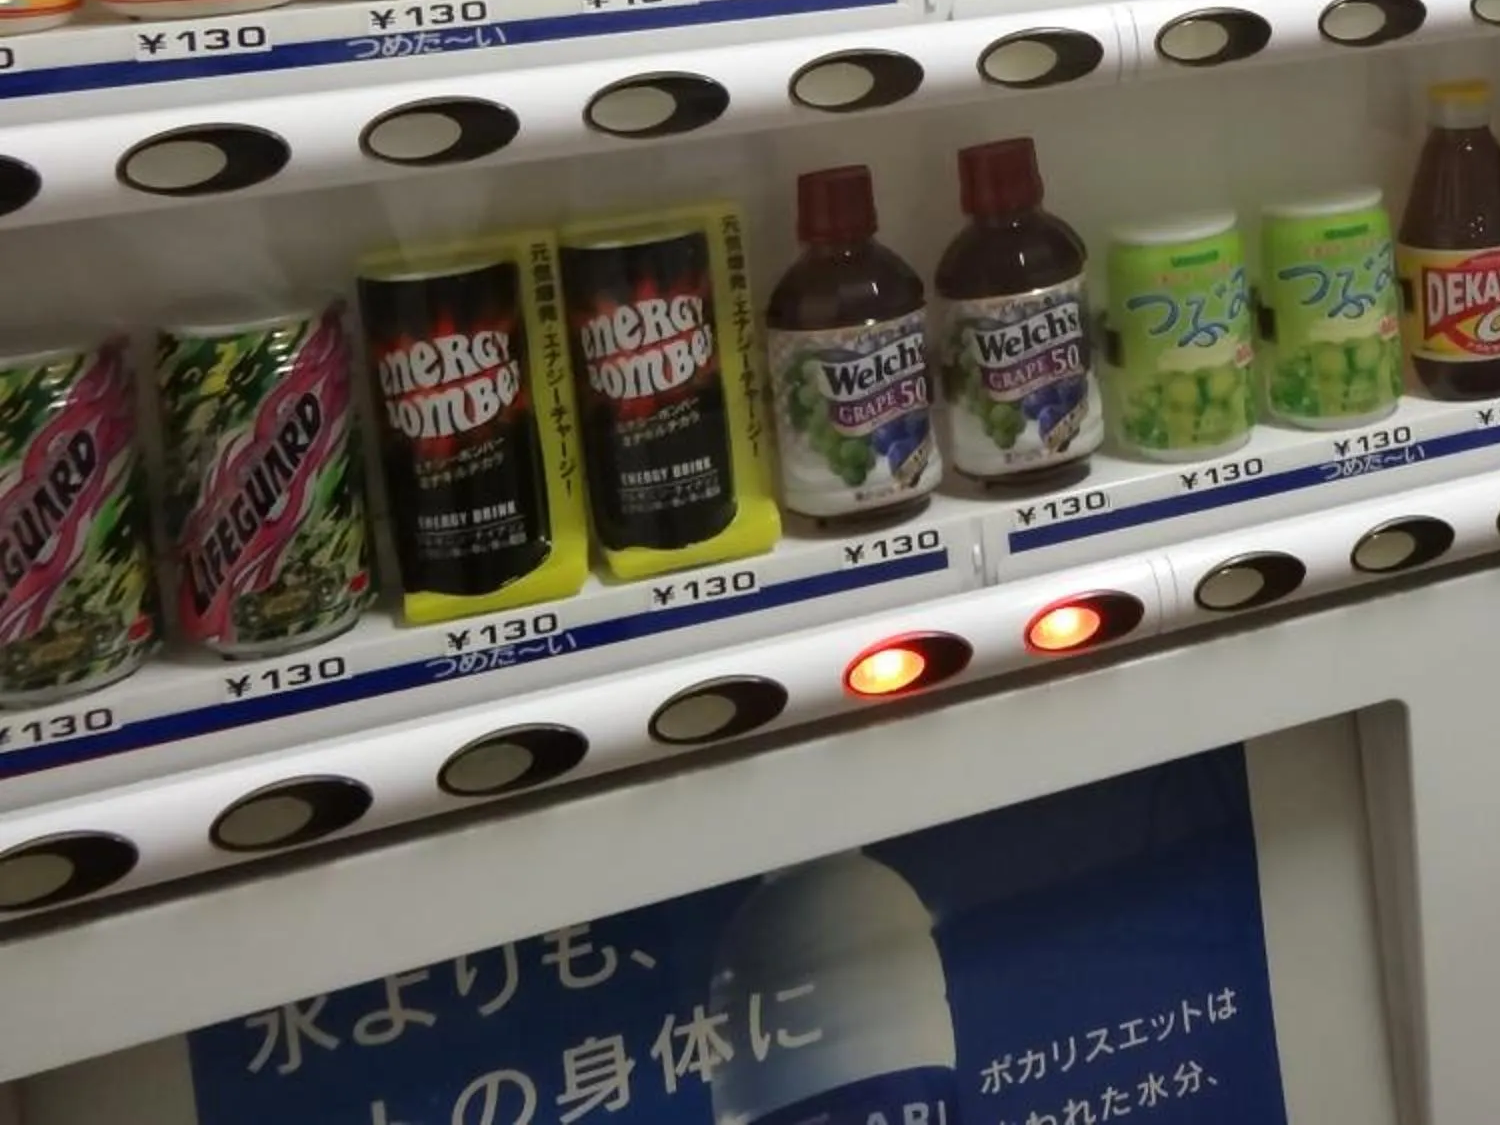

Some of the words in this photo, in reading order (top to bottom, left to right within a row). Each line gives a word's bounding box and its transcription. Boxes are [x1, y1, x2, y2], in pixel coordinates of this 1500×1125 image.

[370, 1, 487, 30] ¥130
[138, 26, 266, 55] ¥130
[974, 304, 1079, 364] Welch's
[989, 357, 1046, 390] GRAPE
[1051, 344, 1080, 374] 50
[838, 391, 896, 425] GRAPE
[899, 377, 927, 408] 50
[1333, 425, 1412, 457] ¥130
[672, 455, 711, 478] DRINK
[1181, 457, 1264, 490] ¥130
[472, 499, 516, 524] DRINK
[1017, 490, 1106, 524] ¥130
[845, 529, 940, 564] ¥130
[652, 570, 756, 605] ¥130
[446, 612, 558, 650] ¥130
[225, 657, 347, 697] ¥130
[980, 987, 1238, 1095] ポカリスエットは
[1001, 1061, 1218, 1125] われた水分、
